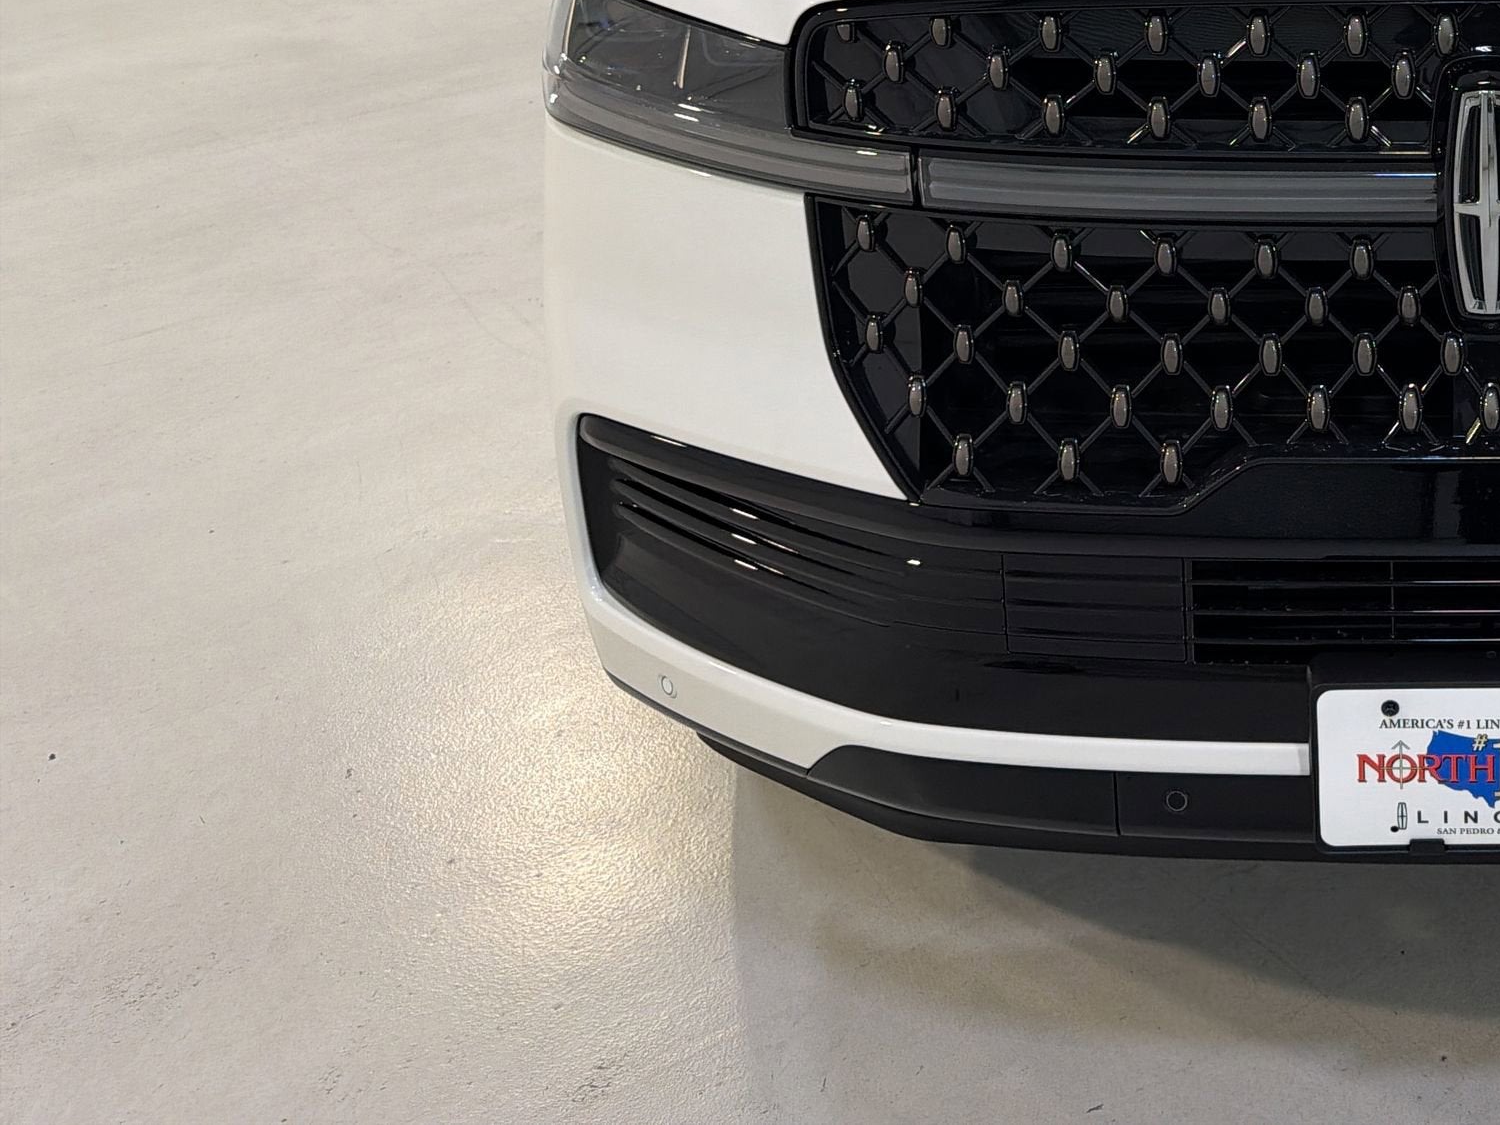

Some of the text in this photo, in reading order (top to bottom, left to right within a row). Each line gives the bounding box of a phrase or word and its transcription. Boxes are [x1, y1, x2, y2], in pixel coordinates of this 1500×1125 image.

[1379, 718, 1454, 730] AMERICA'S
[1457, 719, 1472, 730] #1
[1356, 753, 1496, 784] NORTH
[1436, 827, 1458, 835] SAN
[1460, 827, 1495, 835] PEDRO
